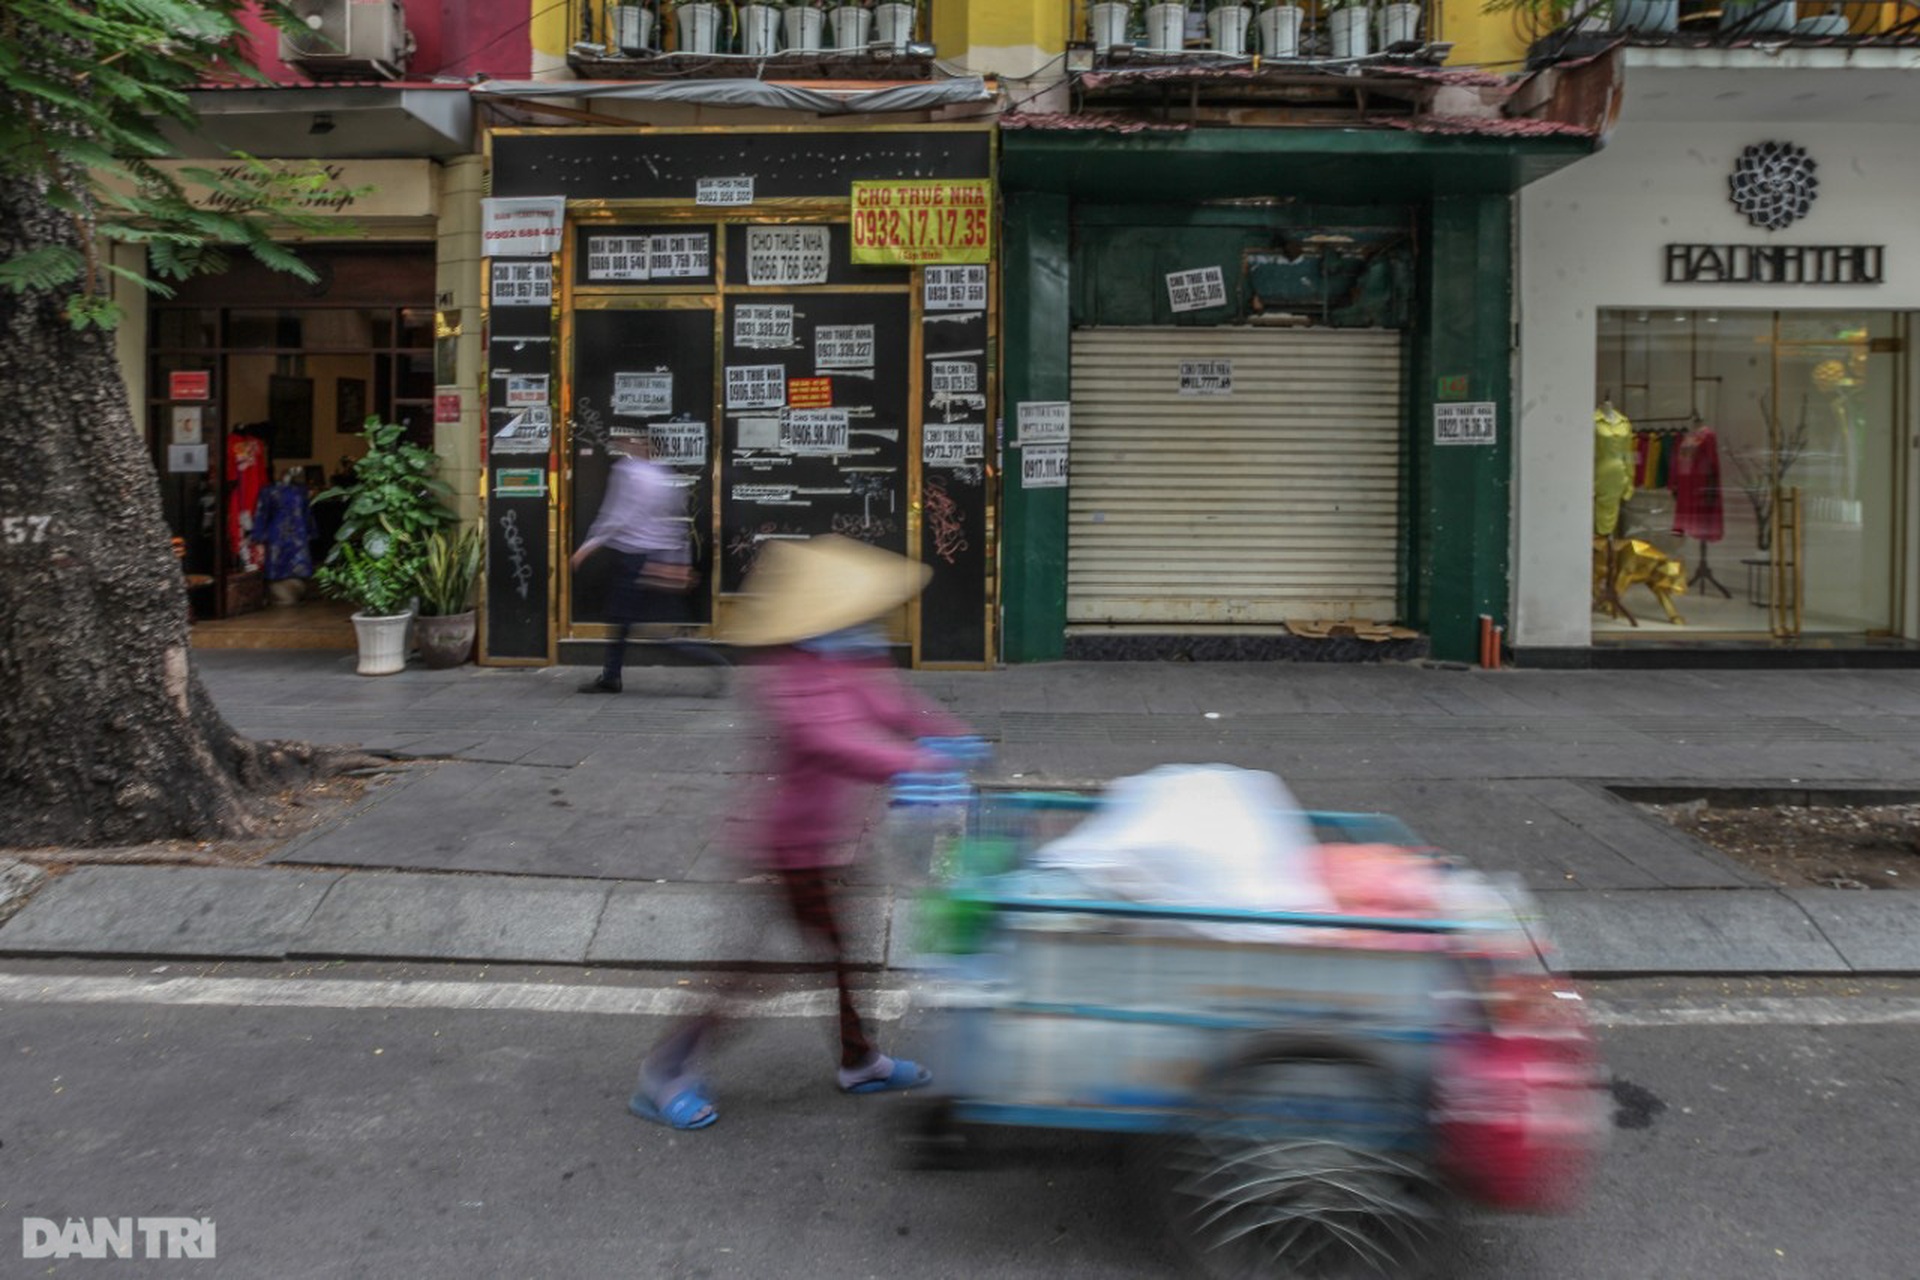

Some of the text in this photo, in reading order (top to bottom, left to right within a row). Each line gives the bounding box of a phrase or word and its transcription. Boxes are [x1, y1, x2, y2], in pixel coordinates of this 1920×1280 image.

[857, 184, 985, 206] CHO THUÊ NHÀ
[751, 233, 772, 252] CHO
[774, 226, 801, 251] THUÊ
[854, 209, 988, 247] 0932.17.17.35
